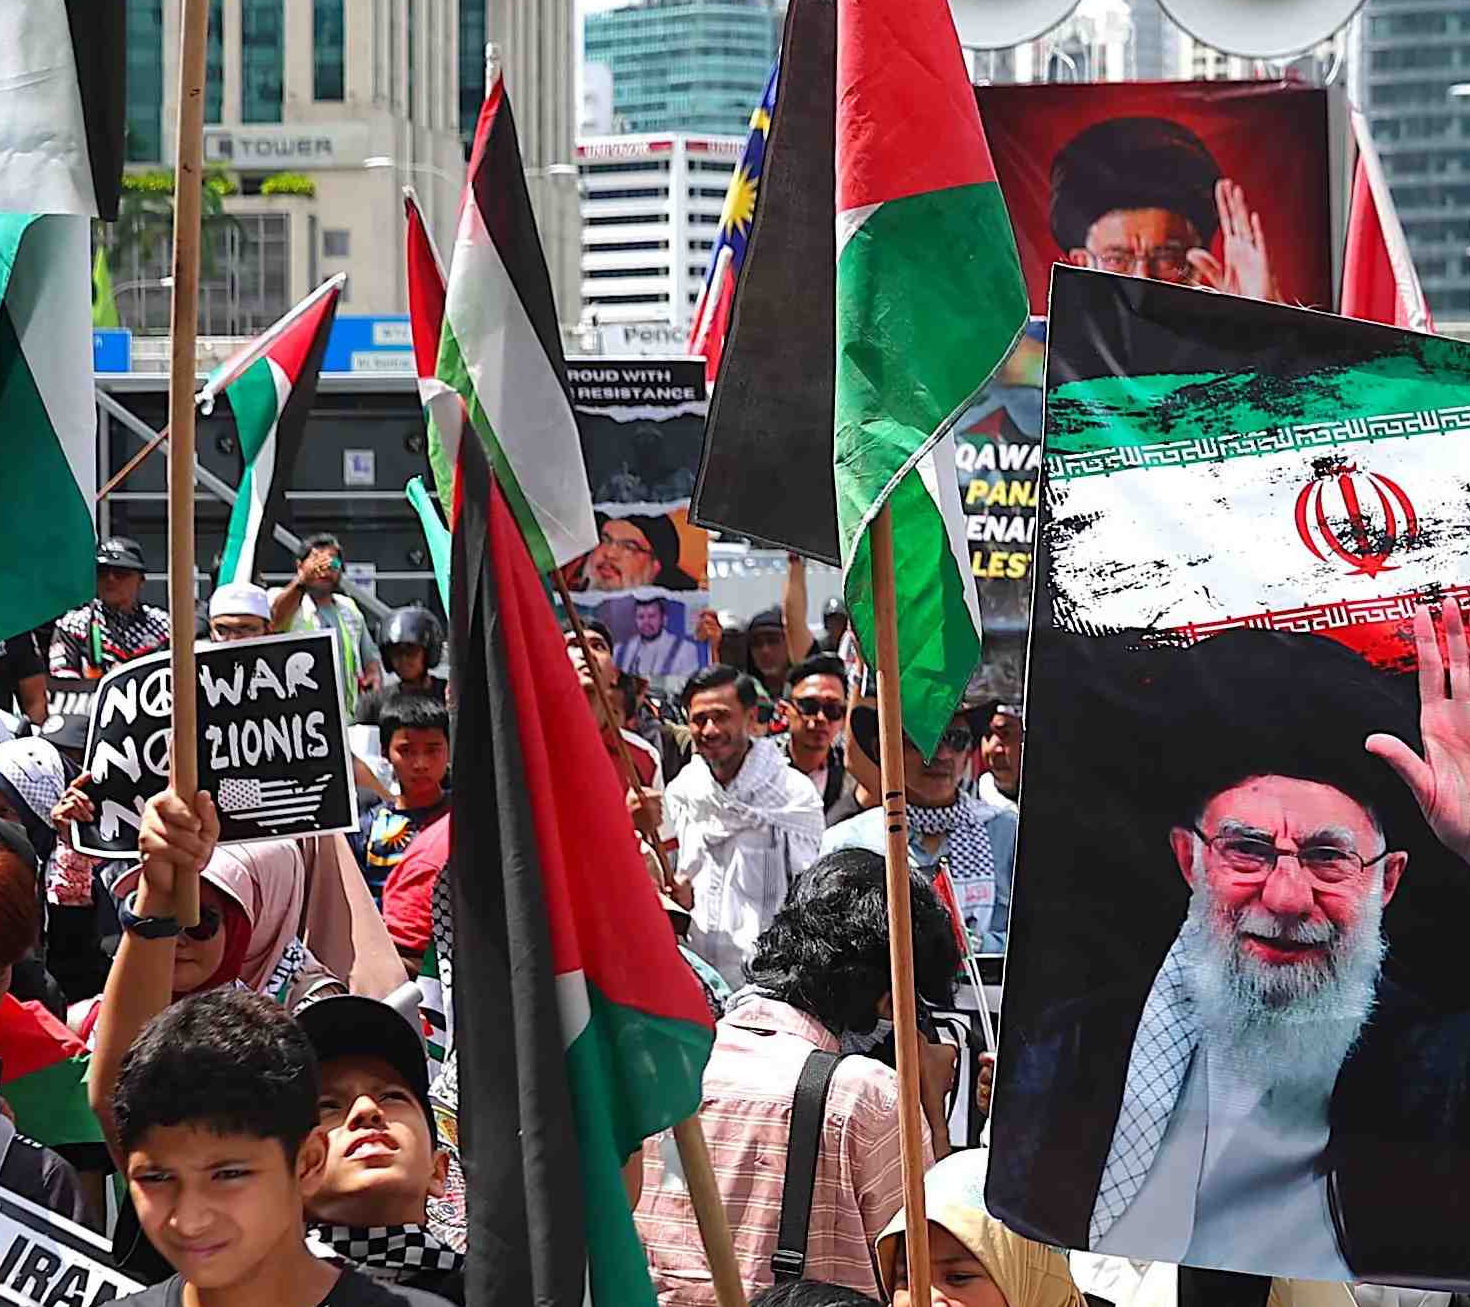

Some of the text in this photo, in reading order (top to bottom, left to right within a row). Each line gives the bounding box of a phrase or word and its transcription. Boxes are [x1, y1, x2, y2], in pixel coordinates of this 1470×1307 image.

[566, 369, 671, 383] ROUD WITH
[578, 386, 696, 401] RESISTANCE
[955, 443, 1041, 472] QAWA
[965, 480, 1039, 507] PAN
[199, 651, 318, 707] WAR
[205, 711, 329, 770] ZIONIS
